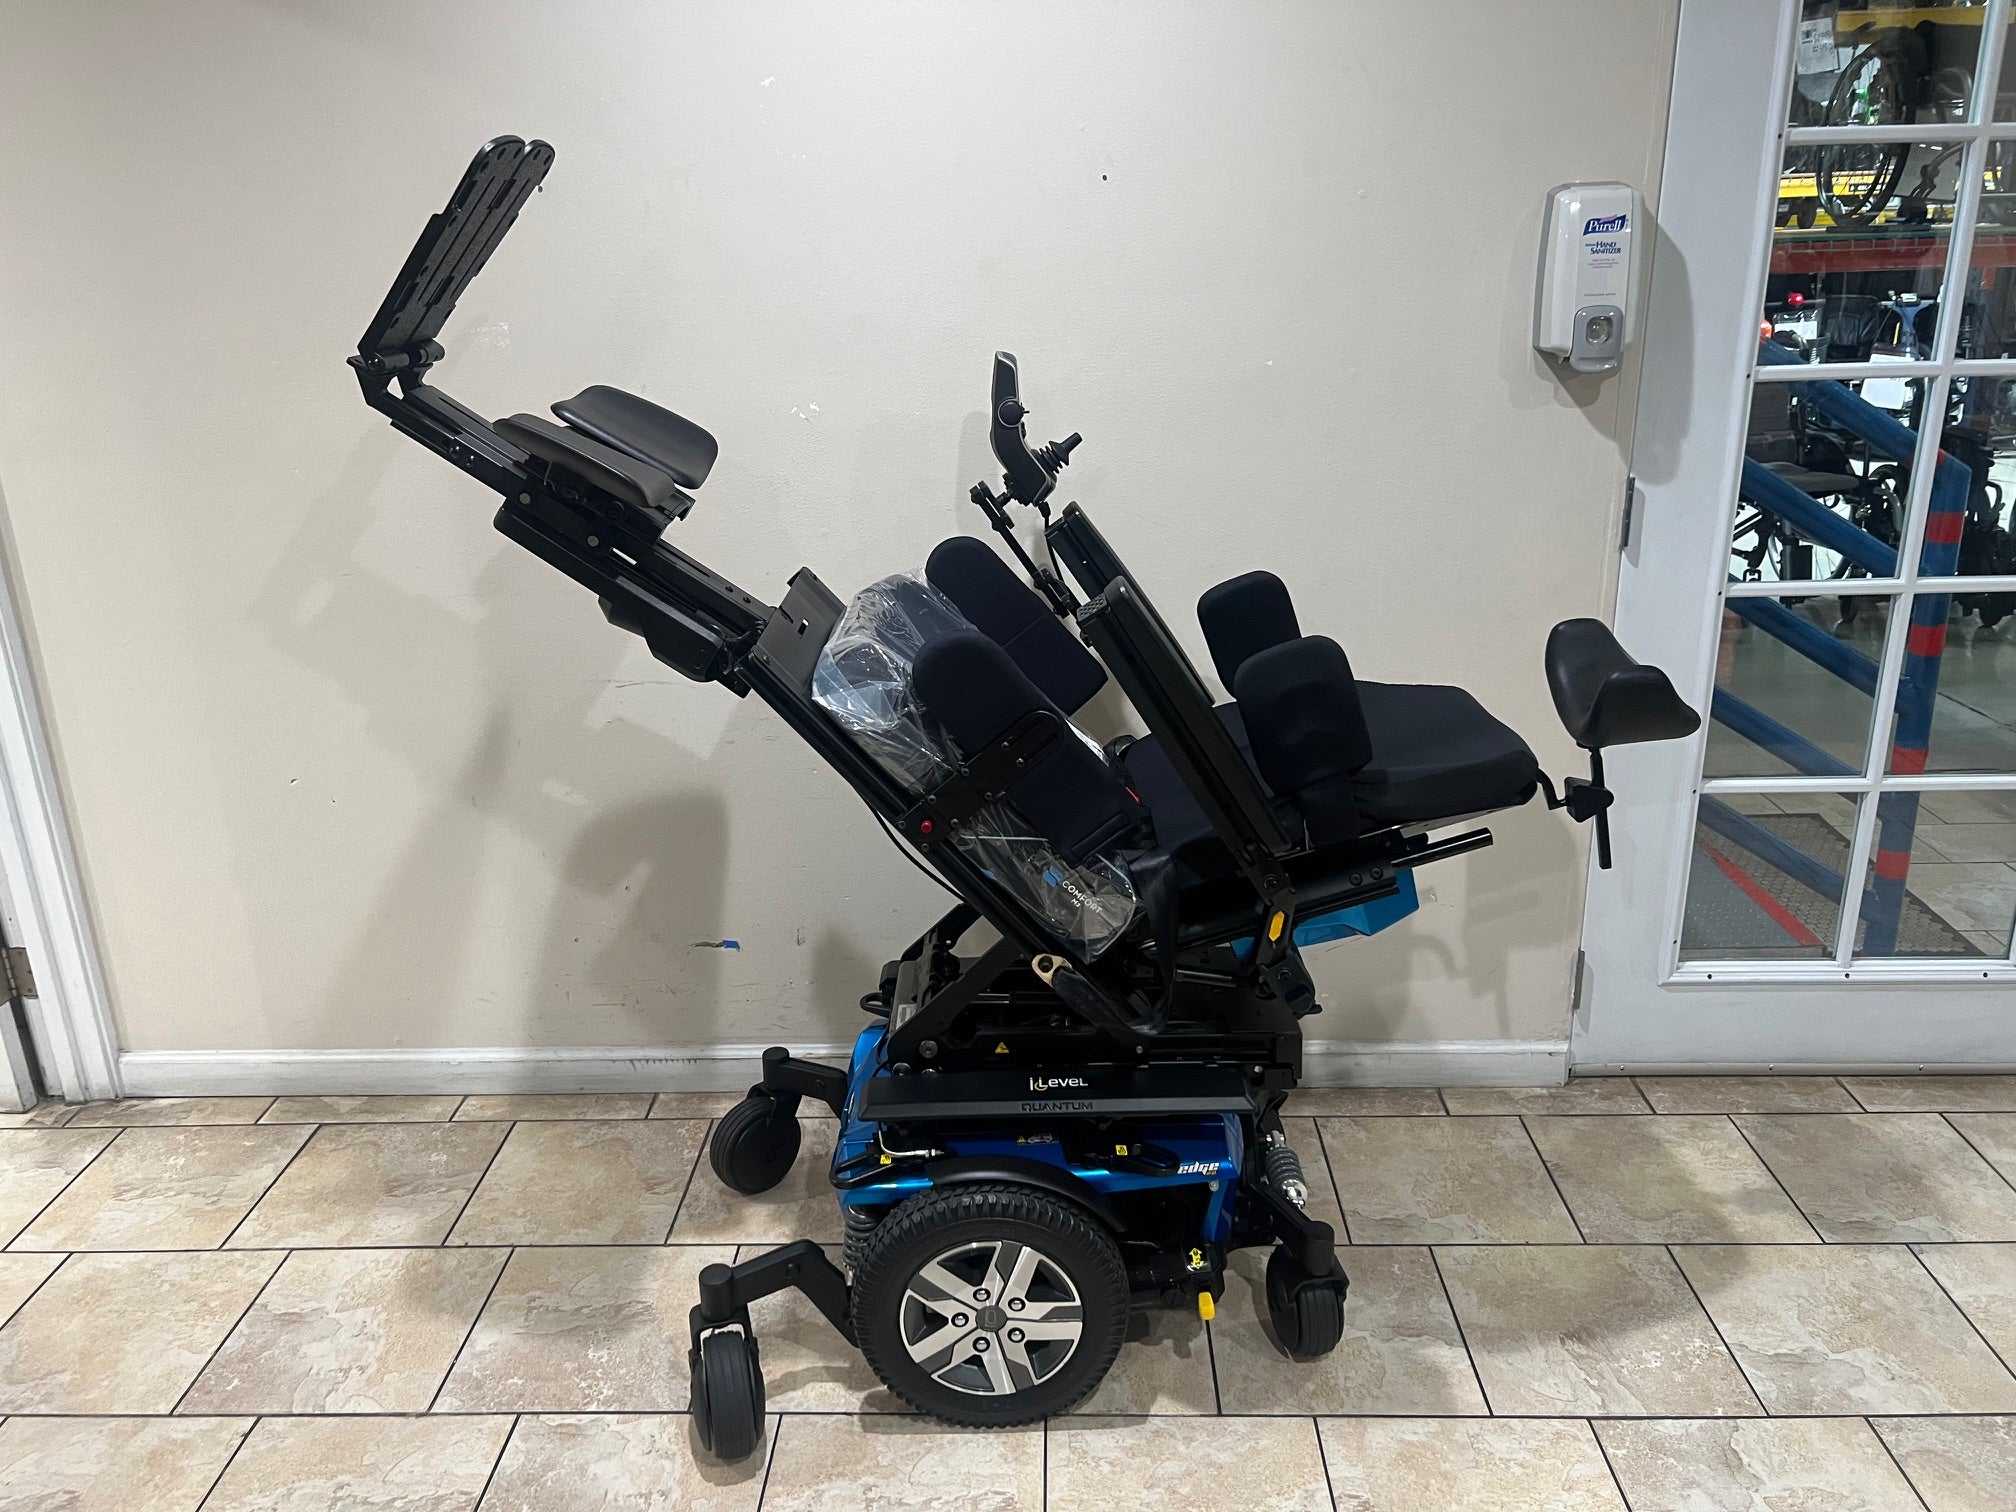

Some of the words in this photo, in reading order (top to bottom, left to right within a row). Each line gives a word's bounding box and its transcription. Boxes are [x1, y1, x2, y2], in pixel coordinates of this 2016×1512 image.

[1588, 219, 1622, 232] Purell
[1595, 240, 1617, 248] HAND
[1590, 247, 1622, 255] SANITIZER
[1062, 880, 1103, 914] COMFORT
[1021, 1101, 1093, 1112] QUANTUM
[1176, 1160, 1220, 1176] edge
